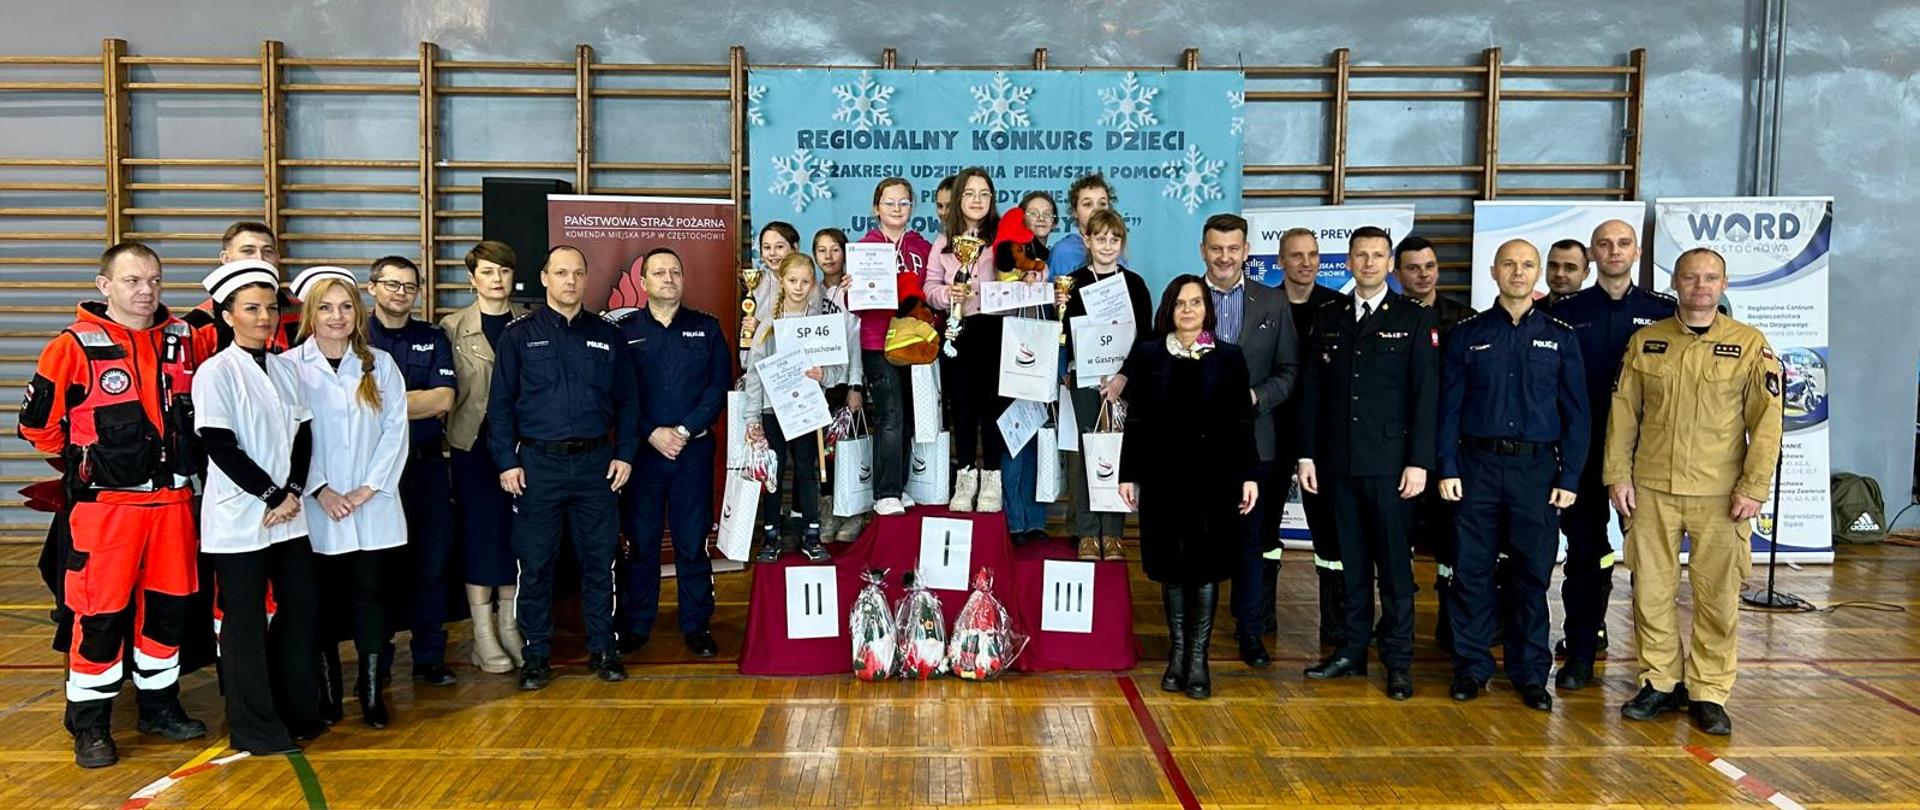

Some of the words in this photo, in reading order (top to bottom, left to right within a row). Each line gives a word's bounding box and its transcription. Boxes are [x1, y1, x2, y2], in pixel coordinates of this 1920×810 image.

[798, 130, 959, 149] REGIONALNY
[972, 130, 1093, 150] KONKURS
[1106, 131, 1185, 150] DZIECI
[829, 165, 903, 178] ZAKRESU
[911, 165, 1006, 178] UDZIENIA
[1110, 166, 1184, 179] POMOCY
[564, 214, 638, 226] PAŃSTWOWA
[640, 215, 674, 227] STRAŻ
[676, 216, 725, 228] POŻARNA
[1688, 213, 1800, 241] WORD
[608, 231, 639, 239] MIEJSKA
[641, 231, 655, 239] PSP
[667, 232, 725, 240] CZĘSTOCHOWIE
[797, 327, 811, 339] SP
[815, 325, 830, 337] 46
[586, 340, 610, 351] POLICJA
[1100, 335, 1113, 346] SP
[1533, 339, 1558, 351] POLICJA
[804, 582, 822, 616] II
[1055, 581, 1083, 612] III
